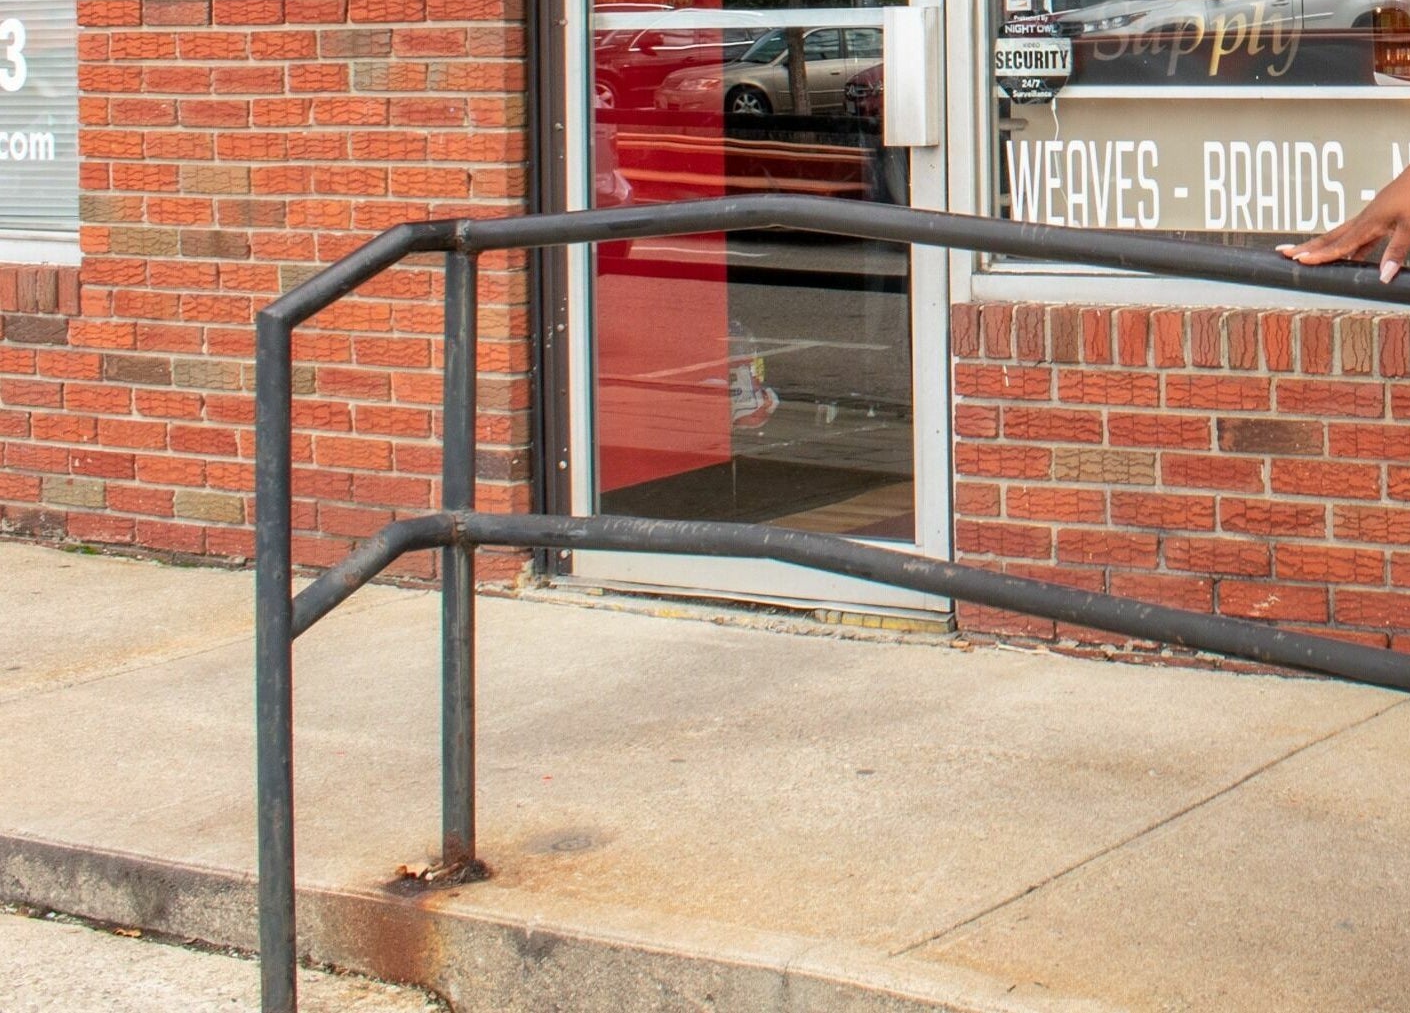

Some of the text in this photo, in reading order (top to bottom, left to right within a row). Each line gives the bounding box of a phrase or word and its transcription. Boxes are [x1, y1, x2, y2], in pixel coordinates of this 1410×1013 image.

[1004, 24, 1058, 34] NIGHT OWL
[995, 50, 1069, 69] SECURITY
[1021, 78, 1041, 88] 24/7
[1006, 139, 1160, 229] WEAVES
[1203, 141, 1345, 231] BRAIDS
